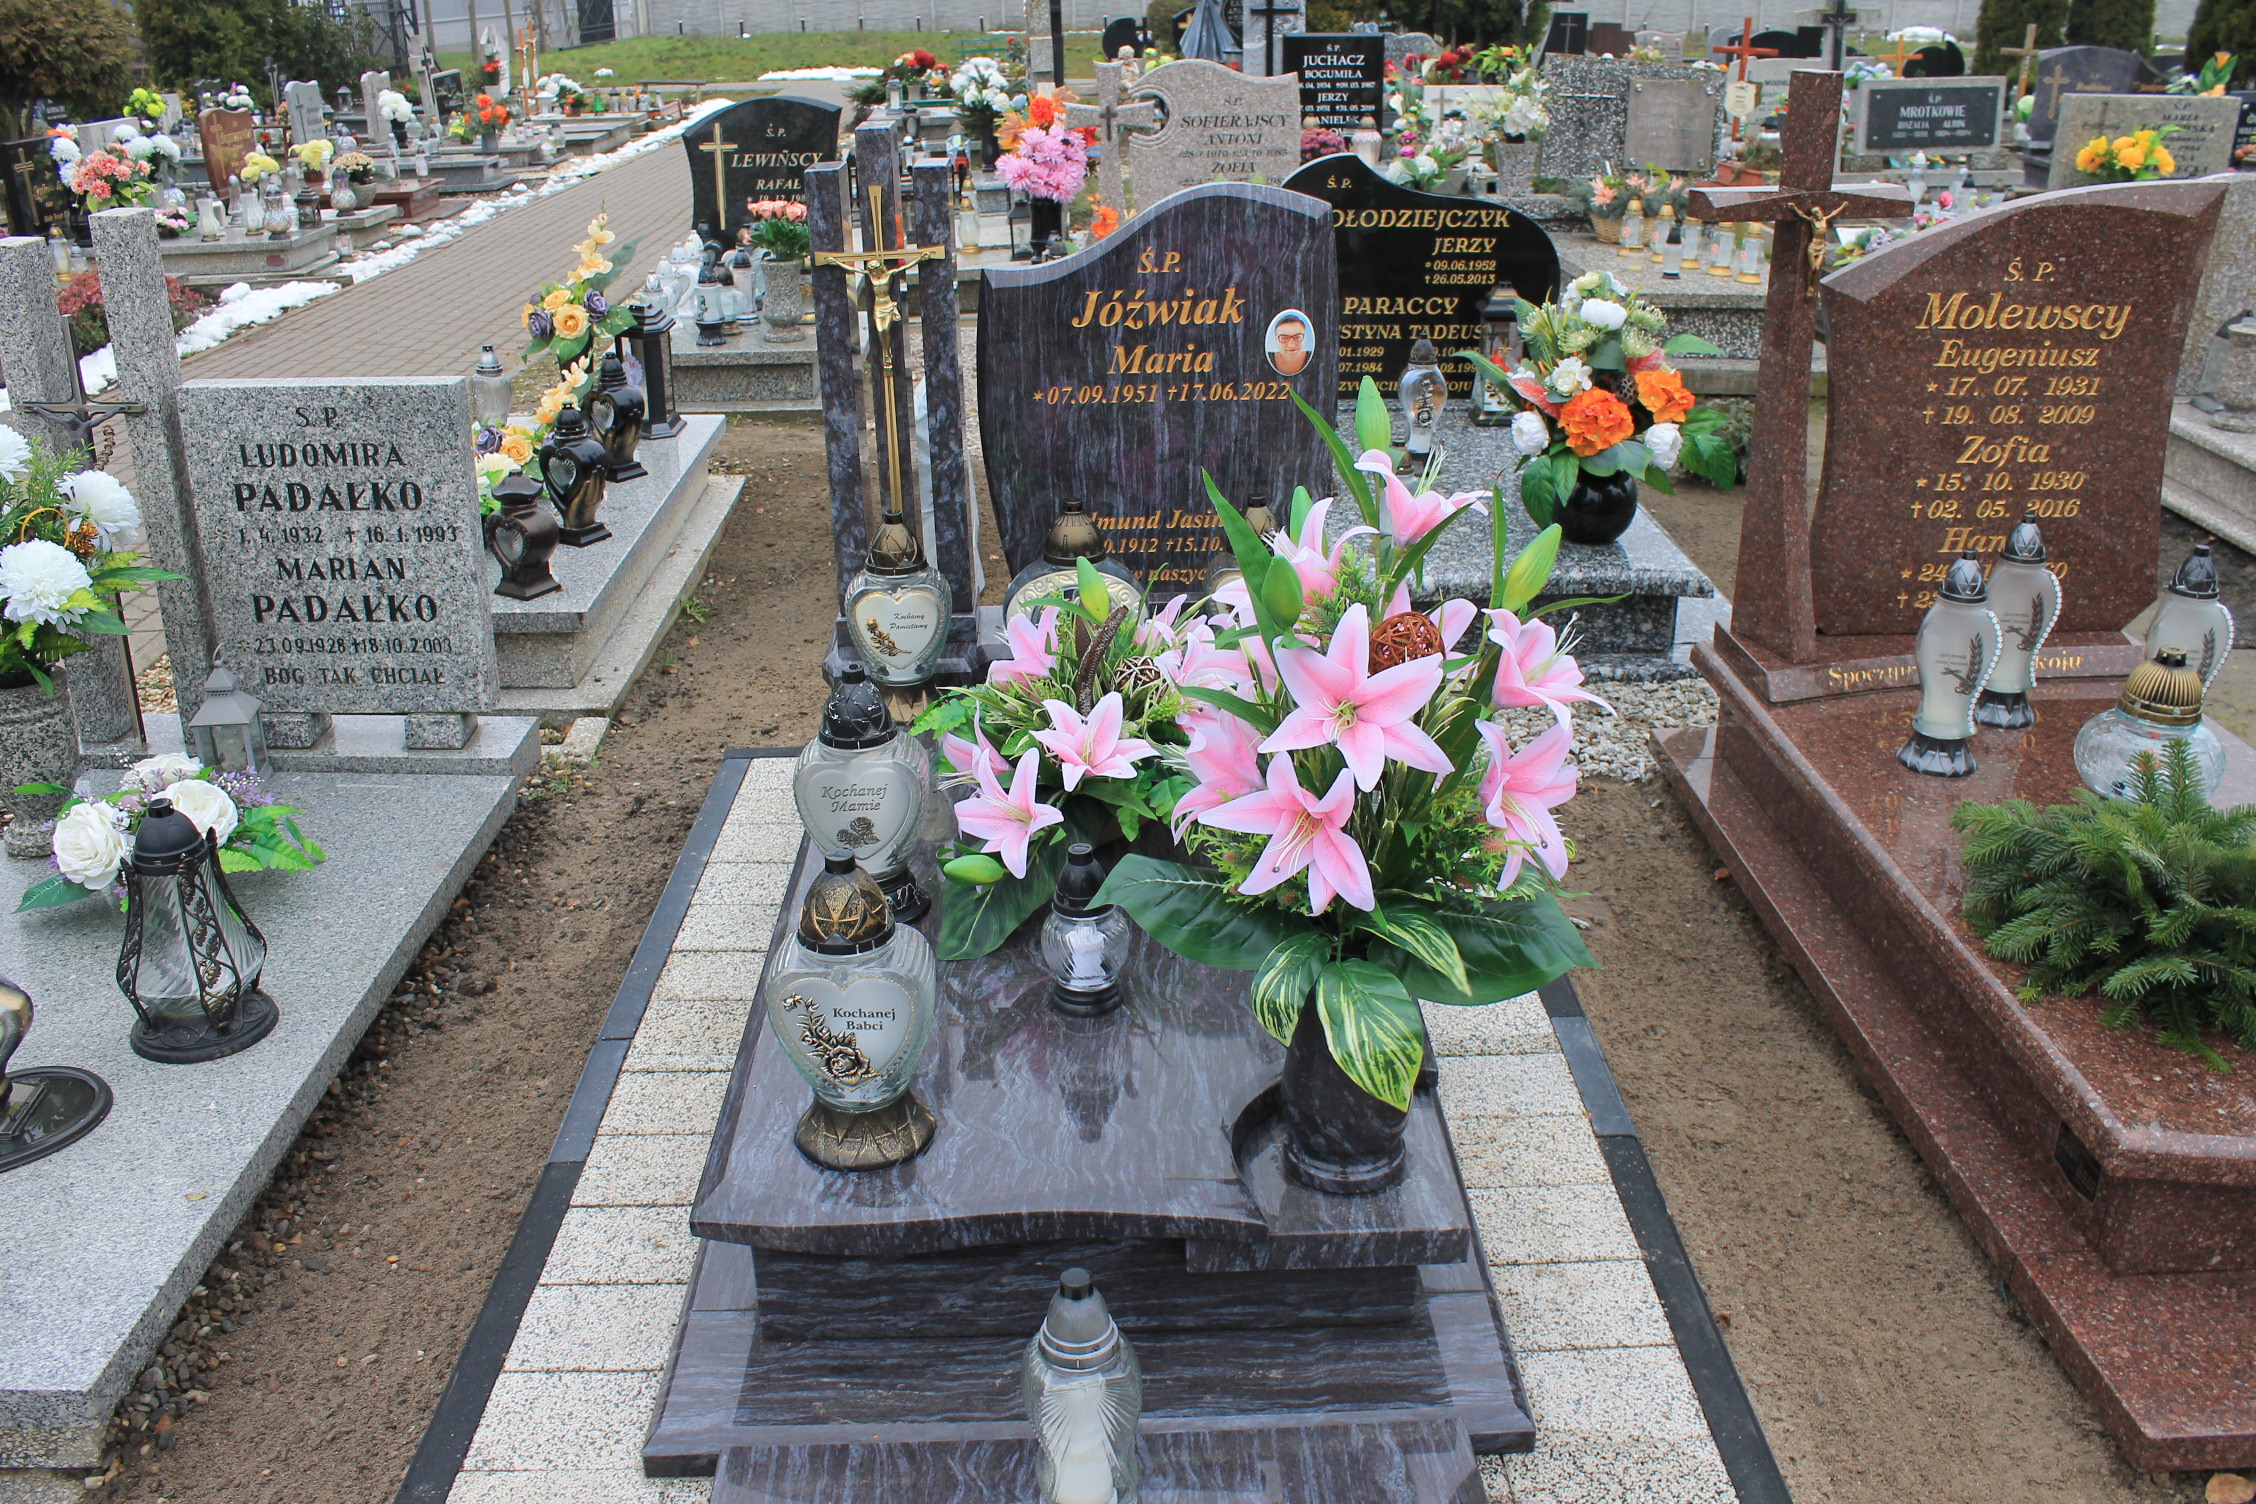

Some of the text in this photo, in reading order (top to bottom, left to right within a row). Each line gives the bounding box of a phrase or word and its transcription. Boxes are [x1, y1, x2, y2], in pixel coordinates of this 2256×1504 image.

[1303, 55, 1365, 68] JUCHACZ
[1304, 70, 1363, 79] BOGUMIŁA
[1317, 93, 1349, 103] JERZY
[1900, 105, 1967, 118] MROTKOWIE
[1202, 133, 1264, 145] ANTONI
[1211, 162, 1256, 173] ZOFIA
[755, 178, 802, 190] RAFAŁ
[1332, 209, 1511, 231] OŁODZIEJCZYK
[1432, 238, 1497, 256] JERZY
[1137, 247, 1181, 274] Ś.P.
[1433, 260, 1496, 271] 09.06.1952
[1432, 274, 1496, 285] 26.05.2013
[1072, 287, 1246, 331] Jóźwiak
[1342, 297, 1459, 315] PARACCY
[1915, 291, 2132, 340] Molewscy
[1339, 324, 1485, 340] STYNA TADEUS
[1107, 343, 1214, 375] Maria
[1339, 346, 1385, 357] 01.1929
[1933, 339, 2101, 374] Eugeniusz
[1338, 362, 1383, 373] 07.1984
[1046, 381, 1291, 405] 07.09.1951 17.06.2022
[1944, 376, 2101, 397] 17. 07. 1931
[1941, 405, 2096, 425] 19. 08. 2009
[239, 443, 406, 468] LUDOMIRA
[1956, 435, 2051, 468] Zofia
[1934, 471, 2086, 492] 15. 10. 1930
[233, 481, 423, 512] PADAŁKO
[1927, 498, 2081, 519] 02. 05. 2016
[1091, 509, 1224, 530] mund Jasin
[1937, 527, 2008, 554] Han
[276, 558, 406, 580] MARIAN
[1148, 567, 1208, 585] naszyc
[253, 594, 438, 623] PADAŁKO
[893, 611, 925, 621] Kochamy
[2035, 650, 2084, 672] koju
[318, 667, 358, 684] TAK
[371, 667, 446, 684] CHCIAŁ
[821, 783, 888, 801] Kochanej
[830, 799, 882, 813] Mamie
[832, 1007, 896, 1022] Kochanej
[846, 1020, 884, 1031] Babci
